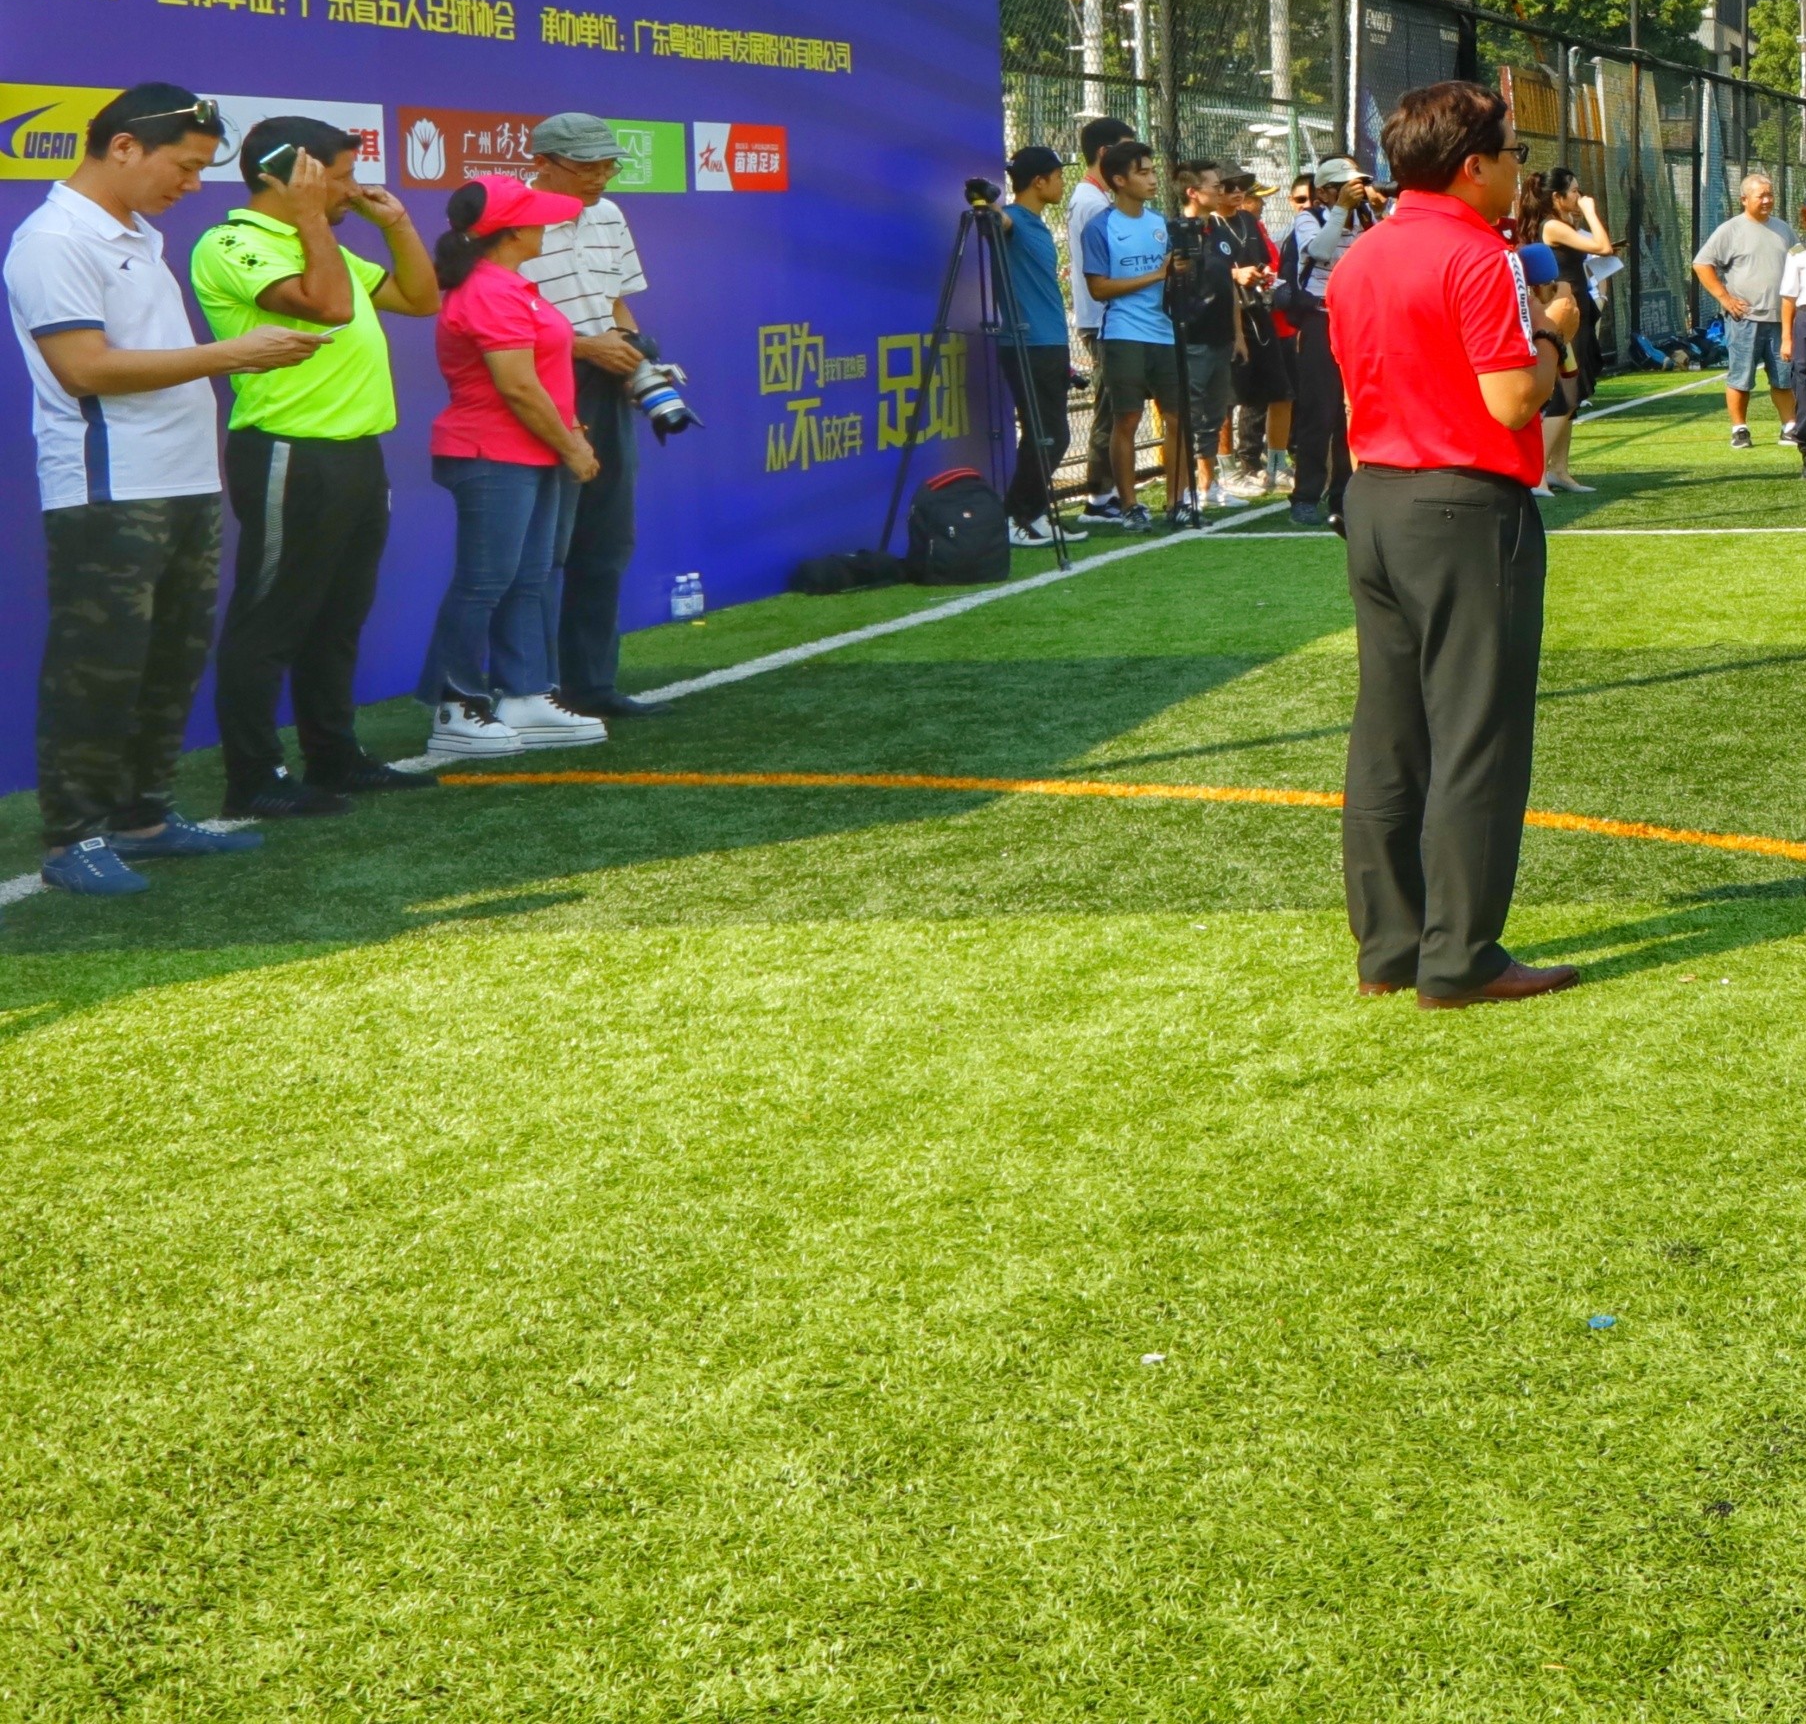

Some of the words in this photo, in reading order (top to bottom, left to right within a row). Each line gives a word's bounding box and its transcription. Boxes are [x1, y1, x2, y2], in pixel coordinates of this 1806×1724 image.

[24, 131, 78, 160] UCAN
[734, 151, 780, 173] 茵浪足球
[765, 397, 863, 472] 从不放弃
